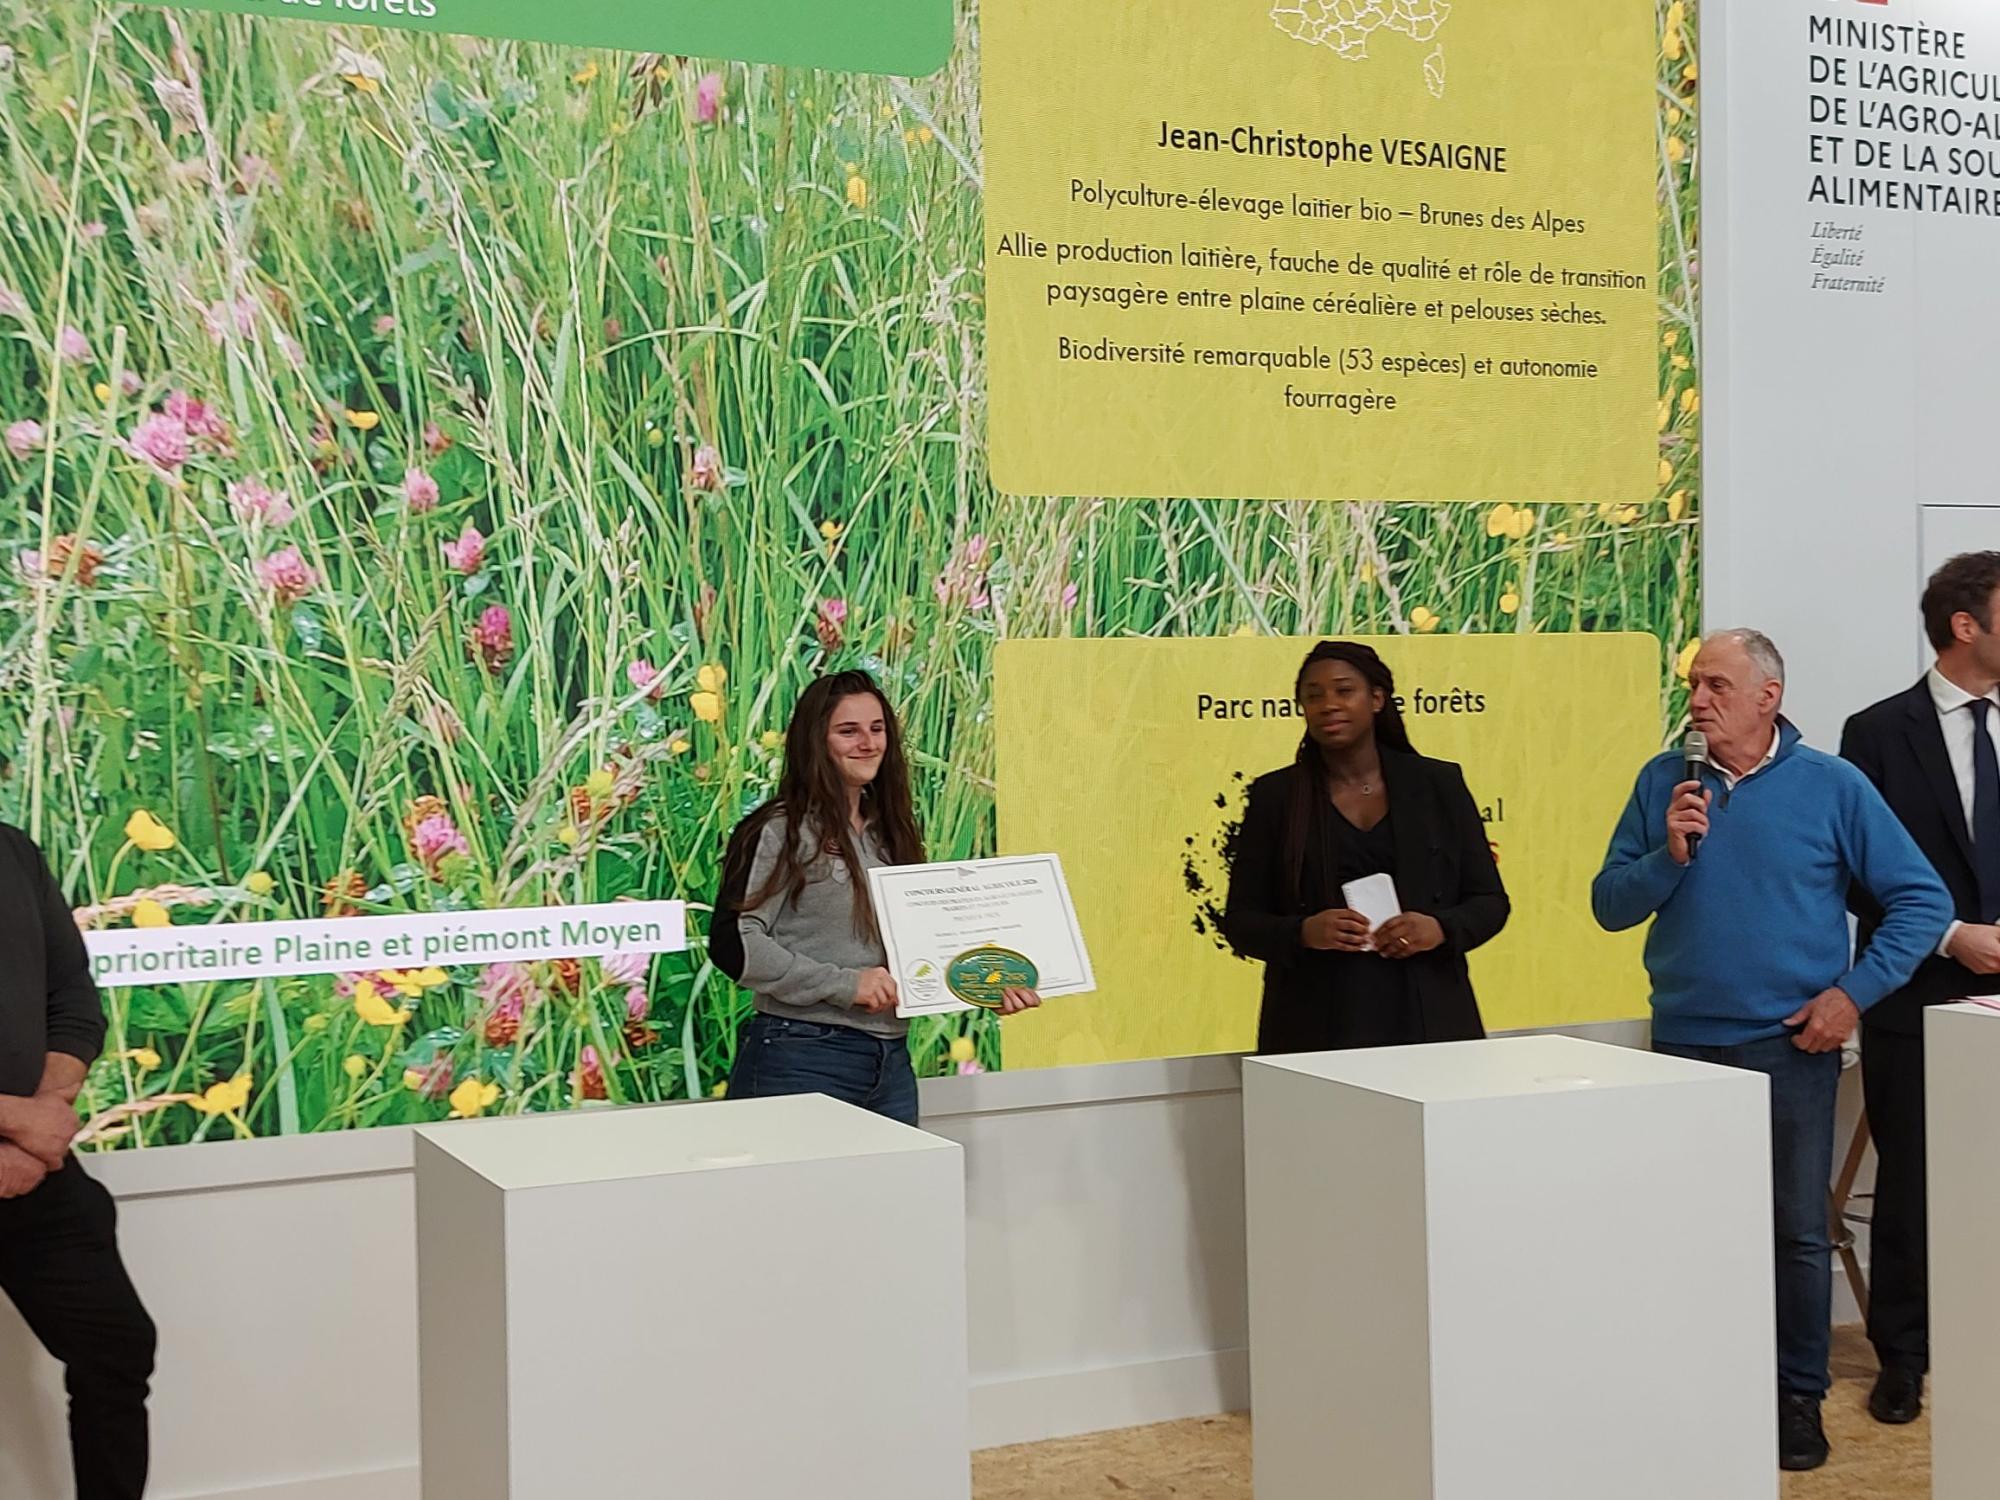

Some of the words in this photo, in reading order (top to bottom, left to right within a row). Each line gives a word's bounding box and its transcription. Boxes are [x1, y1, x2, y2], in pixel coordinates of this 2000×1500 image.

[1810, 15, 1965, 59] MINISTÈRE
[1810, 55, 1847, 86] DE
[1810, 95, 1847, 125] DE
[1158, 121, 1373, 167] Jean-Christophe
[1381, 138, 1507, 172] VESAIGNE
[1810, 135, 1843, 164] ET
[1855, 139, 1891, 169] DE
[1903, 144, 1939, 173] LA
[1071, 179, 1284, 220] Polyculture-élevage
[1292, 193, 1353, 220] laitier
[1360, 197, 1392, 222] bio
[1420, 203, 1483, 228] Brunes
[1491, 206, 1525, 230] des
[1531, 209, 1585, 238] Alpes
[1808, 175, 2000, 217] ALIMENTAIRE
[1810, 221, 1864, 241] Liberté
[997, 232, 1047, 258] Allie
[1057, 238, 1173, 265] production
[1182, 242, 1262, 276] laitière,
[1269, 248, 1339, 275] fauche
[1348, 252, 1374, 276] de
[1382, 256, 1451, 283] qualité
[1458, 263, 1477, 281] et
[1484, 261, 1522, 284] rôle
[1529, 262, 1554, 285] de
[1561, 268, 1647, 290] transition
[1810, 243, 1865, 269] Égalité
[1047, 281, 1168, 309] paysagère
[1177, 288, 1232, 308] entre
[1240, 287, 1305, 314] plaine
[1313, 292, 1417, 317] céréalière
[1424, 300, 1443, 318] et
[1451, 298, 1534, 324] pelouses
[1541, 301, 1607, 325] sèches.
[1810, 273, 1886, 293] Fraternité
[1059, 336, 1185, 364] Biodiversité
[1193, 345, 1331, 373] remarquable
[1339, 347, 1373, 375] (53
[1382, 352, 1467, 379] espèces)
[1474, 358, 1492, 375] et
[1500, 358, 1598, 378] autonomie
[1284, 384, 1397, 415] fourragère
[1198, 695, 1254, 720] Parc
[1413, 688, 1486, 715] forêts
[94, 939, 262, 981] prioritaire
[275, 934, 371, 963] Plaine
[382, 933, 412, 957] et
[424, 925, 551, 961] piémont
[562, 920, 661, 950] Moyen
